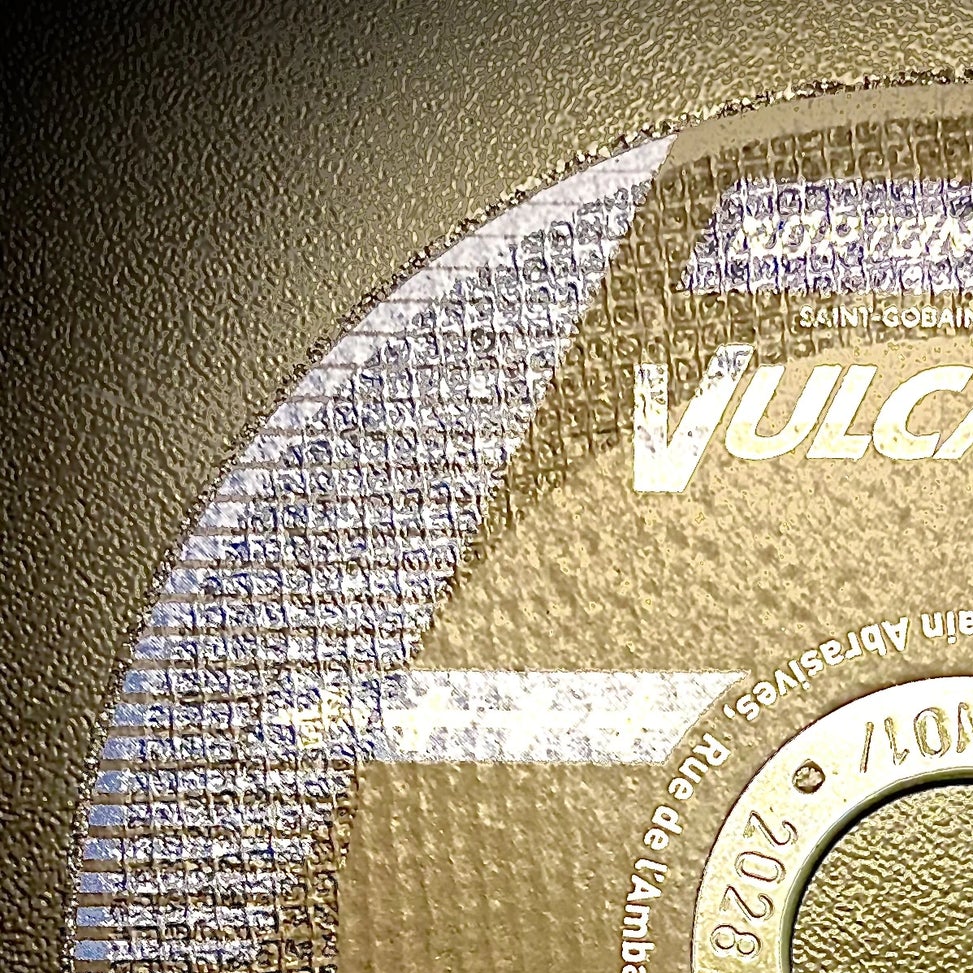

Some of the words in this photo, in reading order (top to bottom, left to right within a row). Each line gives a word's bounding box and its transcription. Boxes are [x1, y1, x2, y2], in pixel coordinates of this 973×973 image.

[722, 616, 910, 722] Abrasives,
[667, 732, 732, 800] Rue
[643, 805, 684, 851] de
